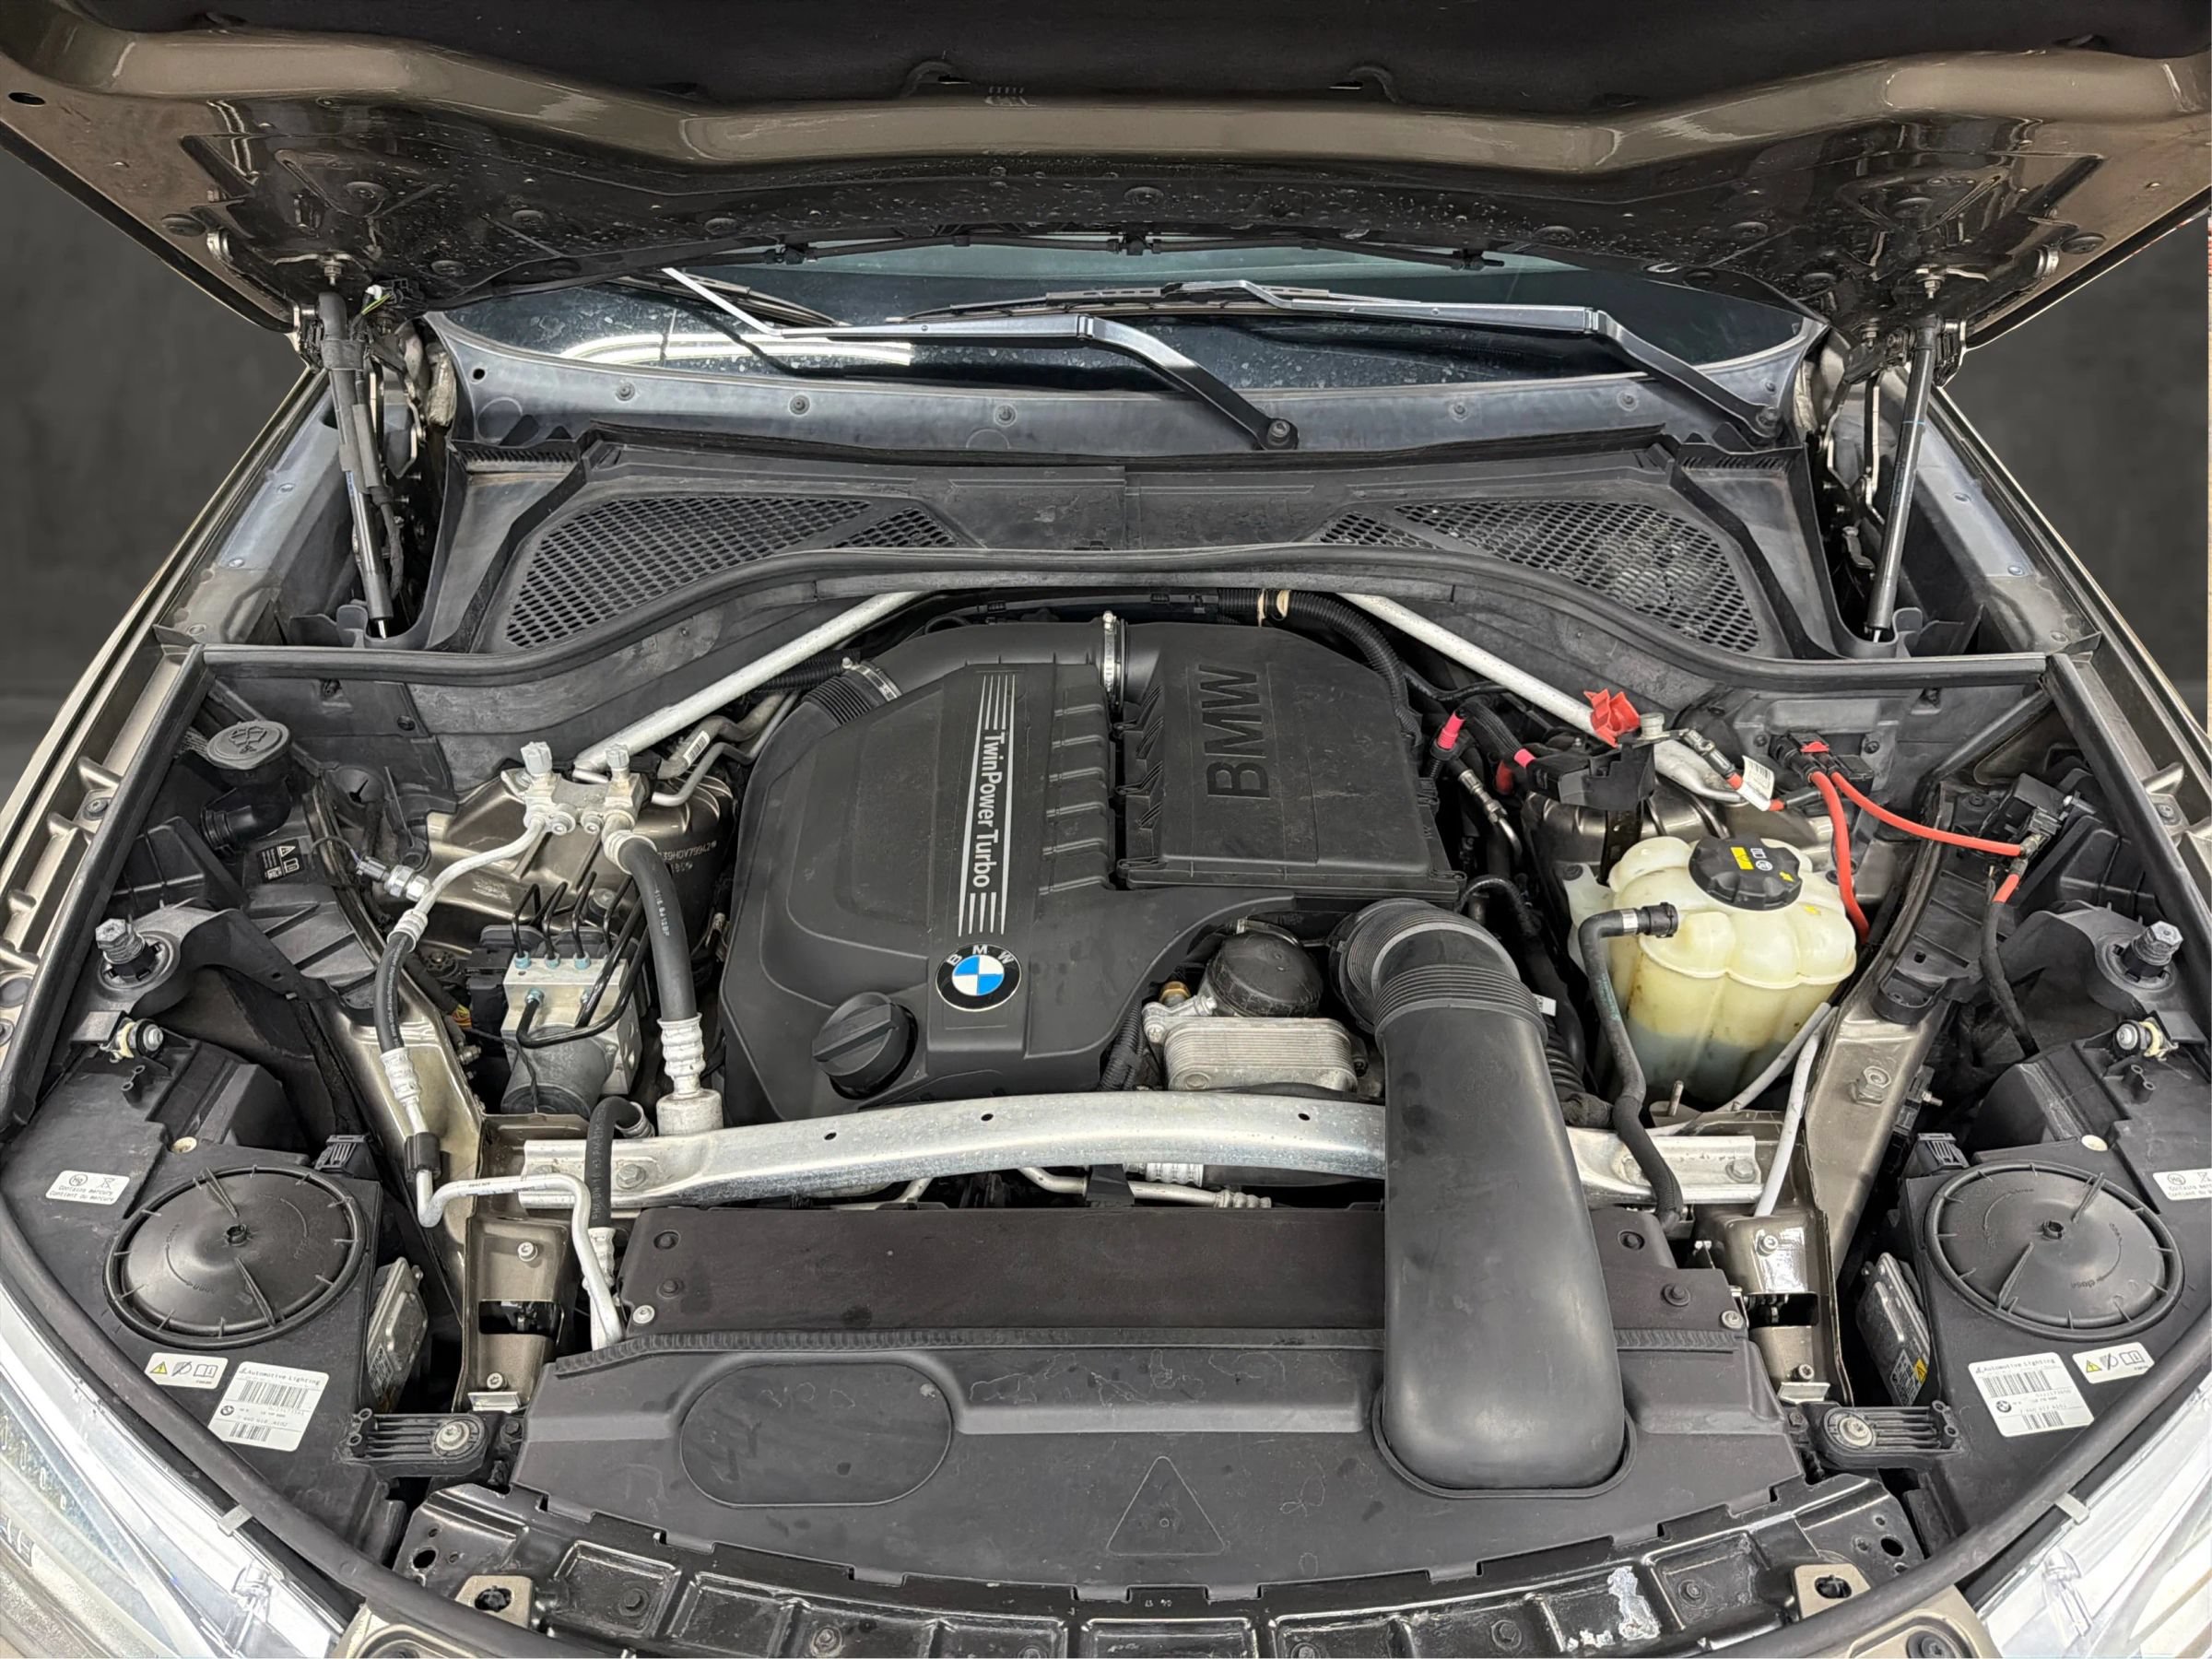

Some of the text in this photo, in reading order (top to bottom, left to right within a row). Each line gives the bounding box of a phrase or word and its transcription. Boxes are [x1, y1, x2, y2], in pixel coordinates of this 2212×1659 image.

[1198, 664, 1271, 801] BMW
[972, 731, 1005, 888] TwinPower Turbo
[946, 944, 1015, 967] BMW
[247, 1369, 287, 1380] Automotive
[288, 1374, 321, 1386] Lighting
[1983, 1362, 2022, 1372] Automotive
